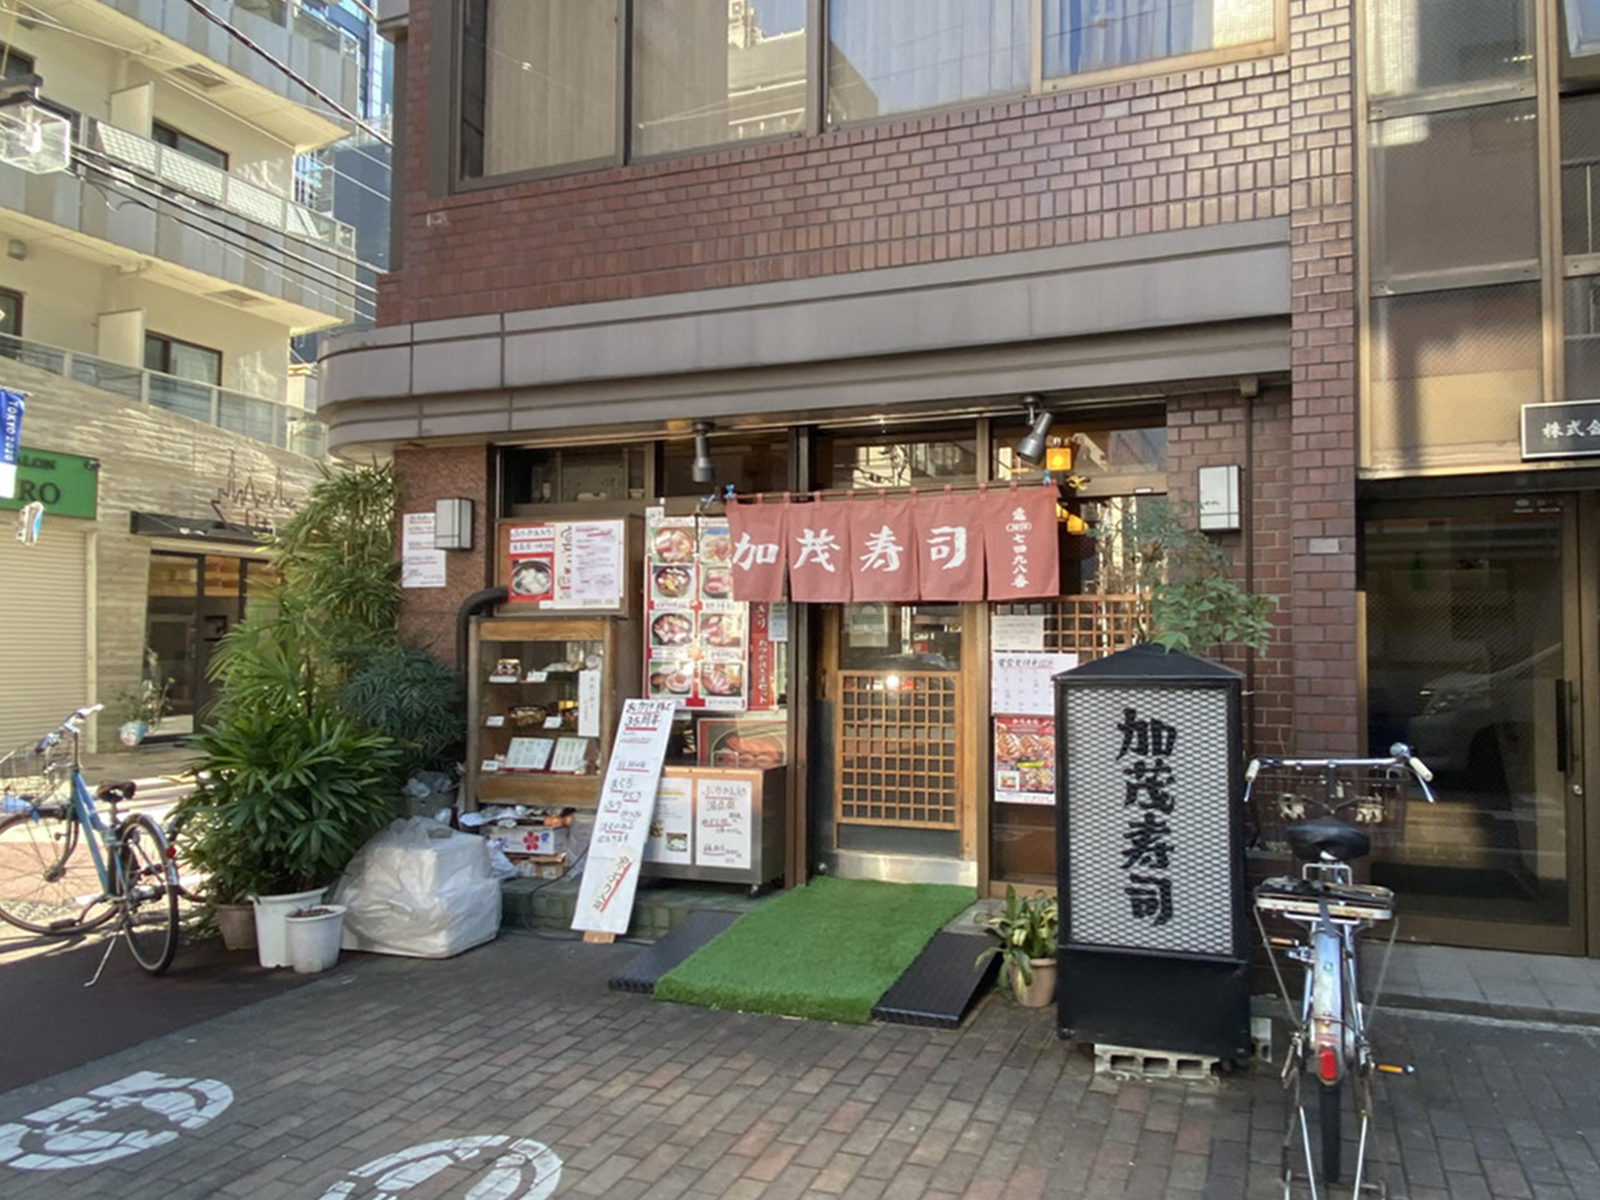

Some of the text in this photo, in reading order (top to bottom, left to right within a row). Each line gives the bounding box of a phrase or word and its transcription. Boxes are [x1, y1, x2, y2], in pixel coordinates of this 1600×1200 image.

[6, 401, 19, 435] TOKYO
[18, 480, 60, 505] RO
[732, 525, 967, 572] 加茂寿司
[625, 714, 660, 726] 35周年
[1116, 708, 1176, 926] 加茂寿司
